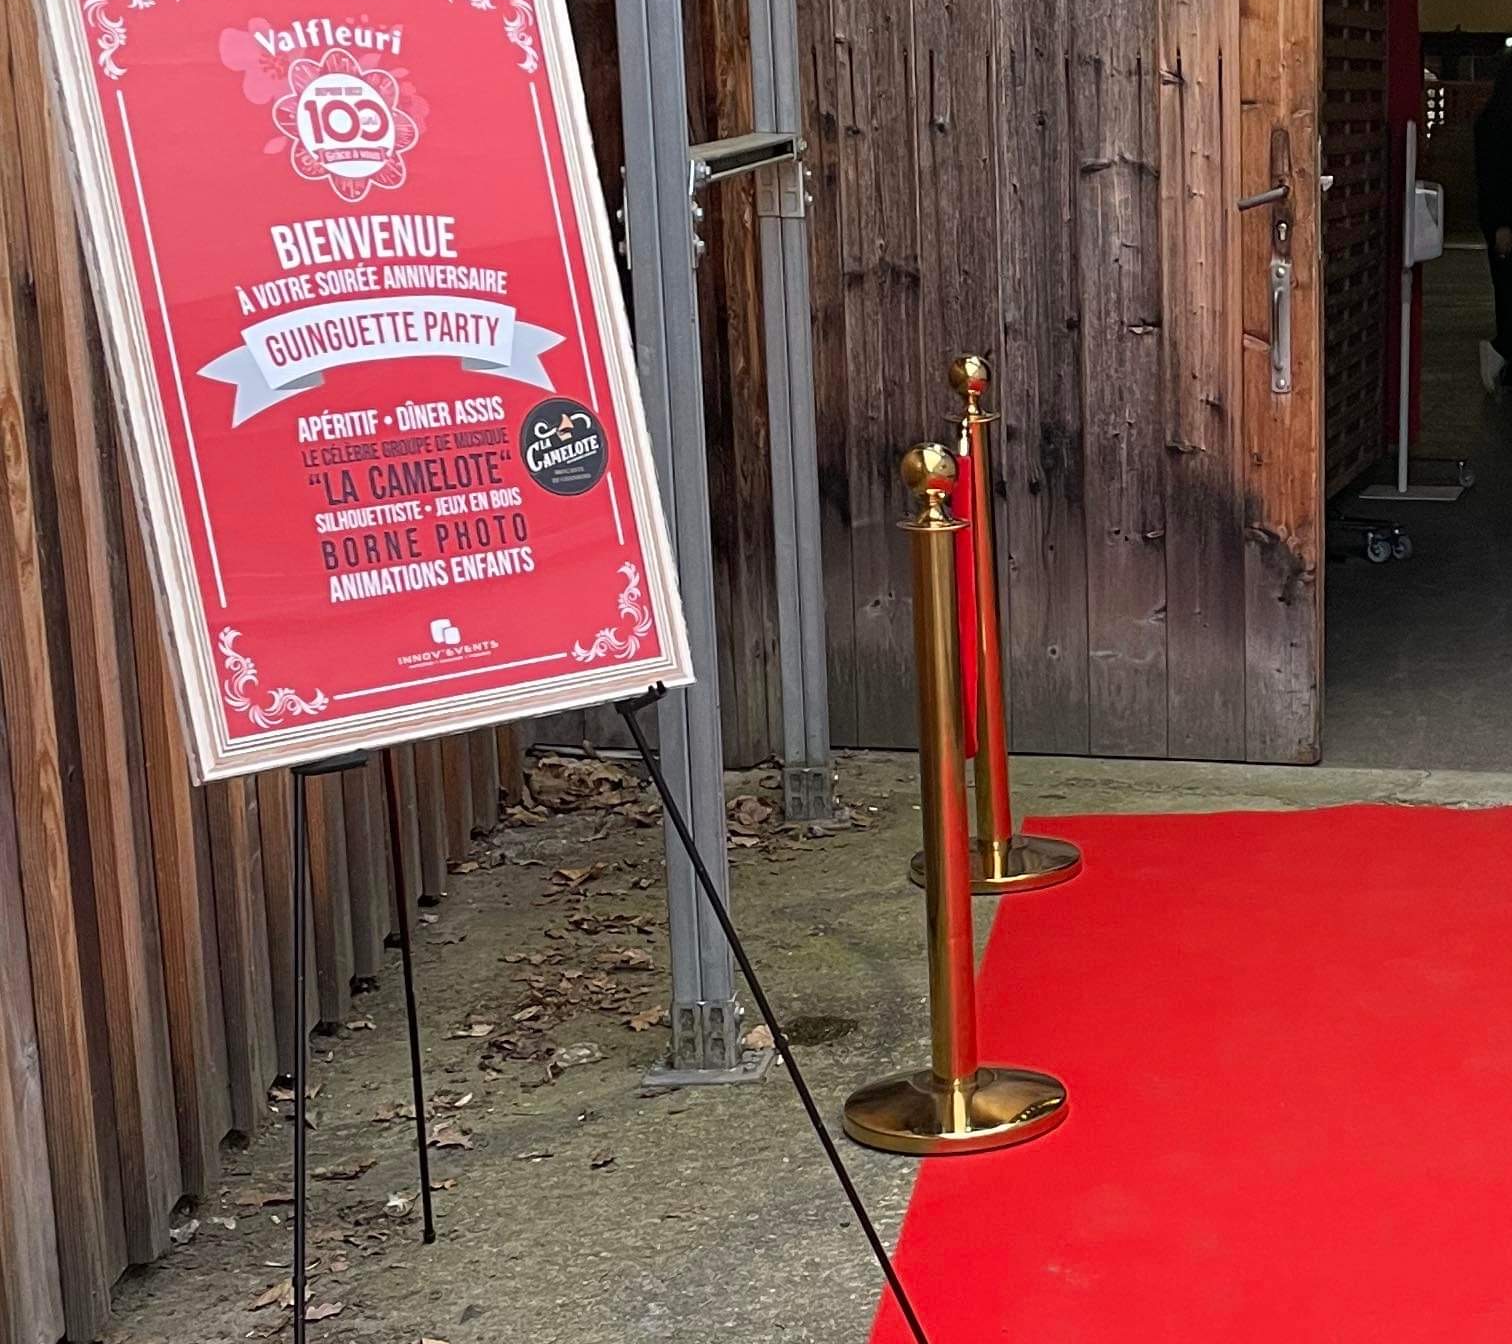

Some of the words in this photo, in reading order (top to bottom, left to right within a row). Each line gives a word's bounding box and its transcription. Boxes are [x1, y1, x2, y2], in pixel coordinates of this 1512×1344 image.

[254, 18, 402, 56] Valfleuri
[304, 99, 389, 144] 100
[270, 215, 458, 270] BIENVENUE
[234, 285, 256, 316] À
[251, 272, 316, 309] VOTRE
[316, 262, 379, 297] SOIRÉE
[383, 265, 508, 295] ANNIVERSAIRE
[265, 311, 419, 368] GUINGUETTE
[424, 311, 500, 347] PARTY
[298, 409, 379, 443] APÉRITIF
[397, 400, 451, 431] DÎNER
[454, 396, 505, 424] ASSIS
[301, 449, 320, 468] LE
[434, 432, 453, 452] DE
[454, 427, 511, 449] MUSIQUE
[526, 435, 600, 472] CAMELOTE
[315, 501, 423, 534] SILHOUETTISTE
[435, 494, 469, 517] JEUX
[470, 492, 490, 515] EN
[492, 487, 522, 509] BOIS
[321, 527, 423, 571] BORNE
[435, 512, 528, 554] PHOTO
[329, 560, 449, 603] ANIMATIONS
[452, 546, 535, 584] ENFANTS
